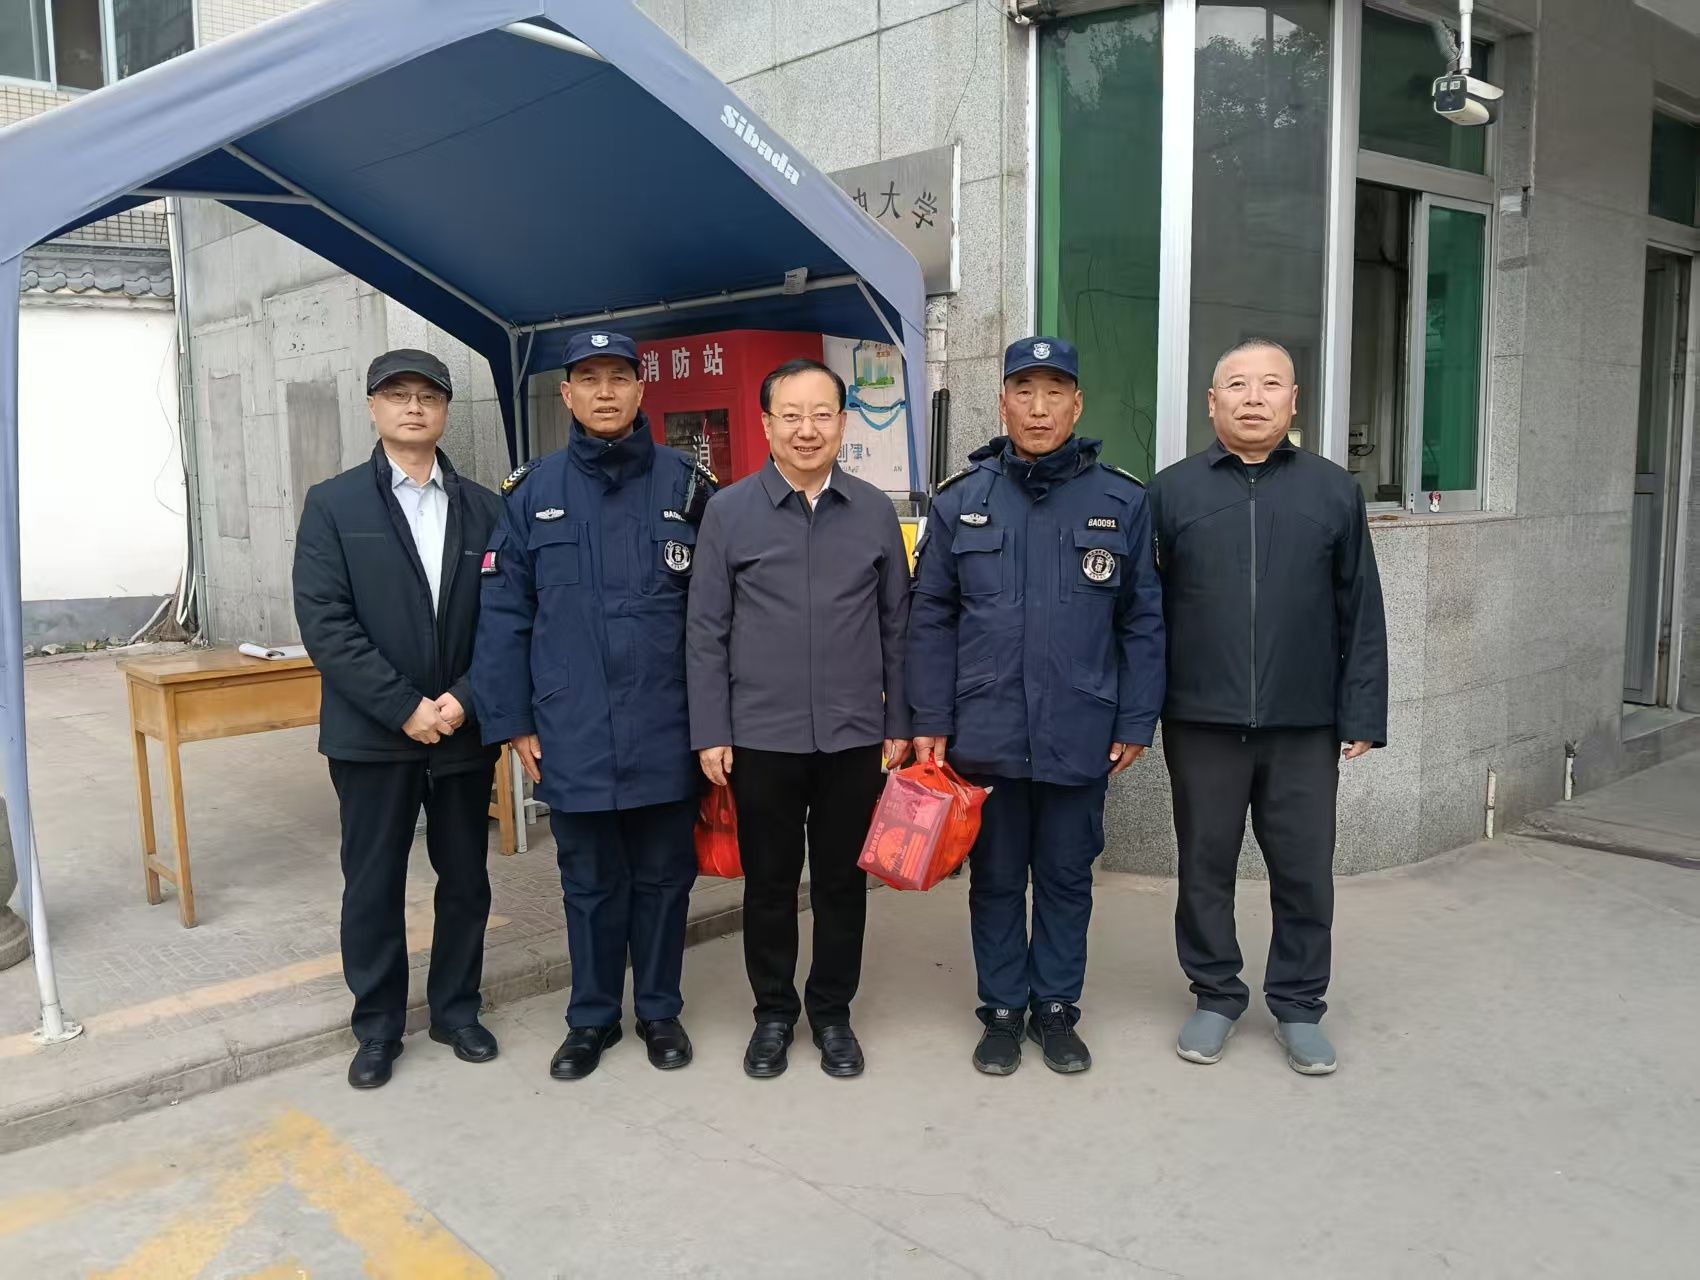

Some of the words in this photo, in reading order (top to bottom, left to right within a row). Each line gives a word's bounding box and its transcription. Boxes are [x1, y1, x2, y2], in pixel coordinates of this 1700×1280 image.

[720, 104, 800, 185] Sibada
[641, 342, 724, 383] 消防站
[1088, 518, 1116, 528] BA0091
